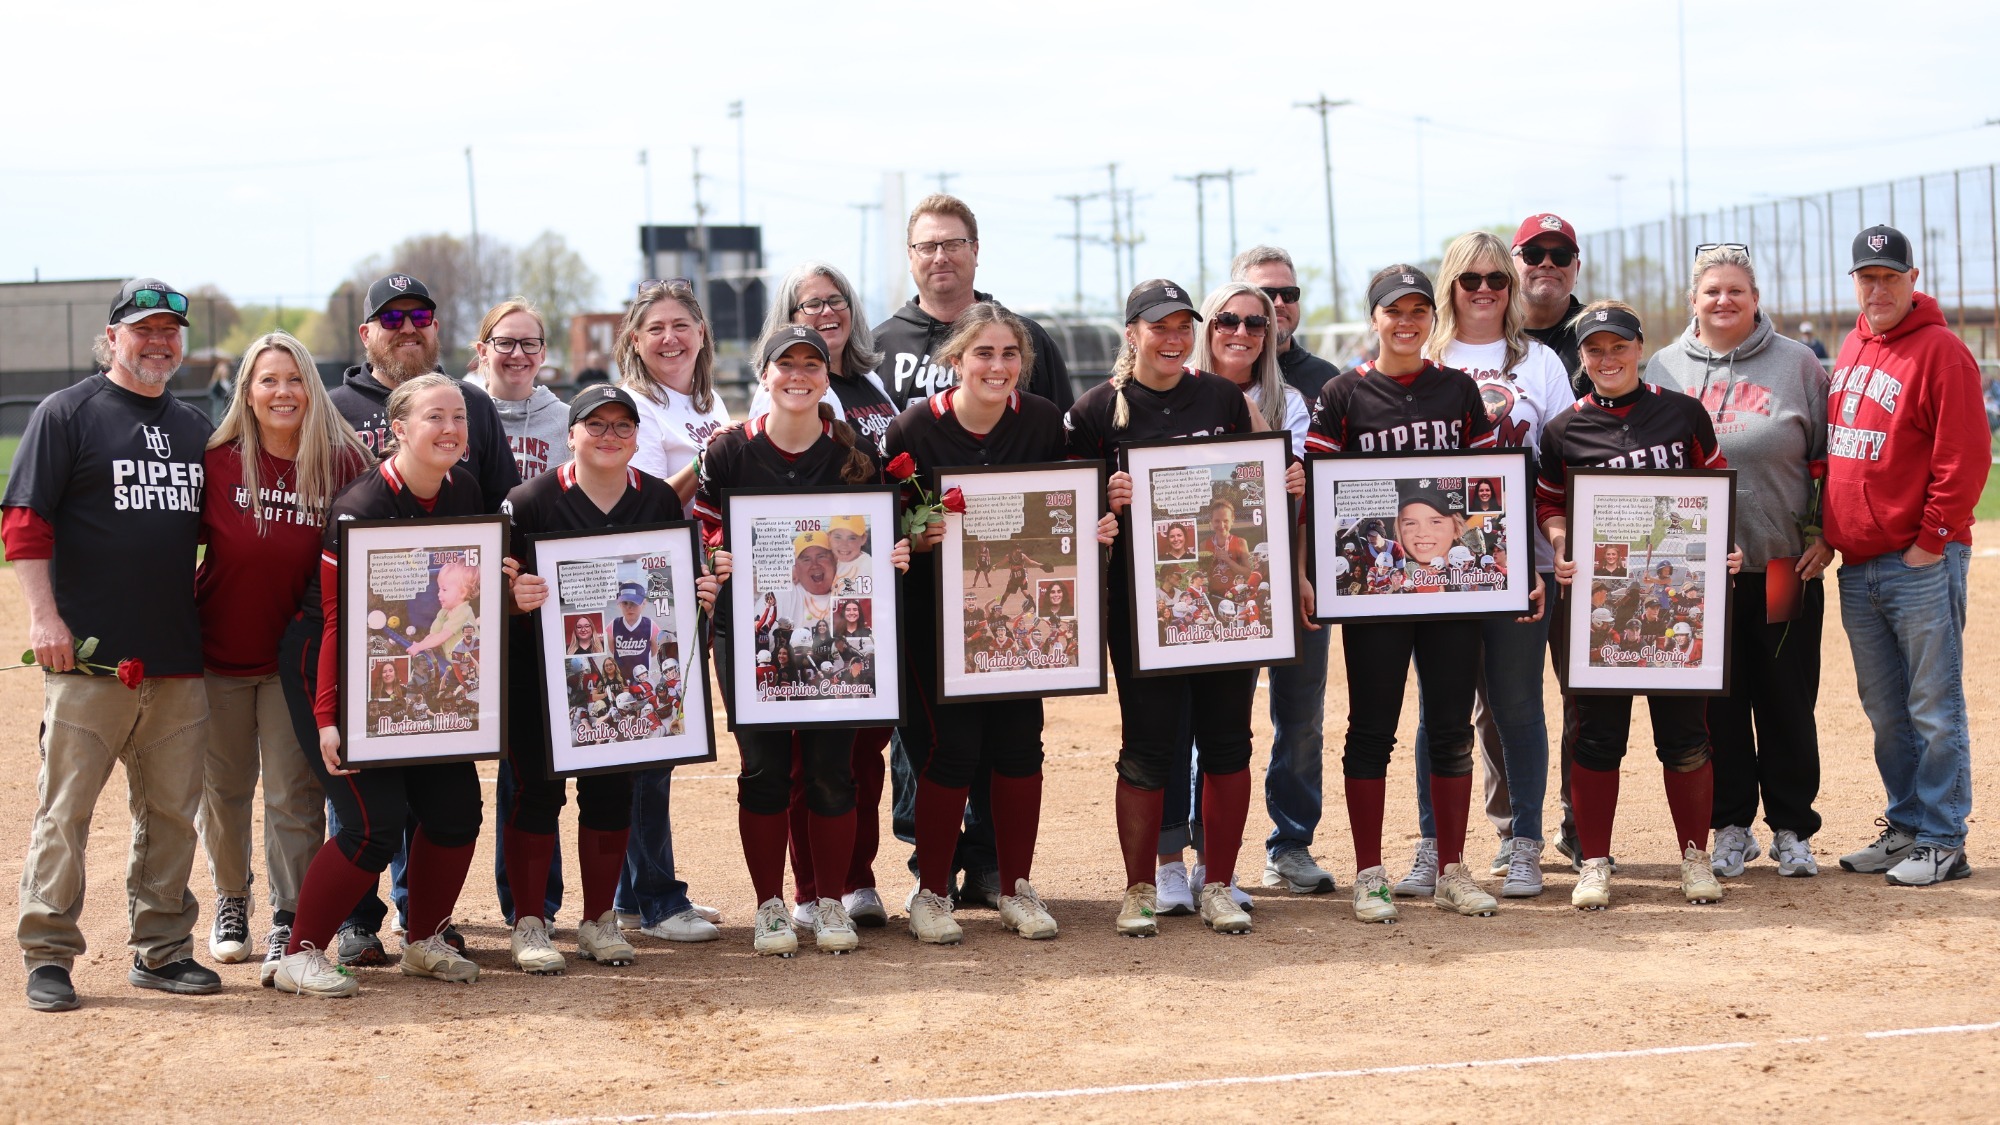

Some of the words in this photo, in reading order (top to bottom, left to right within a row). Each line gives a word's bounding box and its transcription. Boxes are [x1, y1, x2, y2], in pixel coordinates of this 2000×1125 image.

[1359, 419, 1462, 452] PIPERS
[1827, 423, 1887, 461] VERSITY
[1236, 466, 1262, 479] 2026
[1437, 478, 1462, 490] 2026
[1046, 493, 1072, 506] 2026
[1677, 497, 1702, 509] 2026
[1252, 508, 1263, 526] 6
[1482, 516, 1493, 534] 5
[1691, 514, 1702, 531] 4
[794, 520, 821, 532] 2026
[1061, 536, 1071, 554] 8
[433, 552, 458, 565] 2026
[463, 549, 479, 567] 15
[642, 556, 666, 570] 2026
[855, 576, 873, 594] 13
[654, 598, 670, 618] 14
[615, 635, 648, 650] Saints
